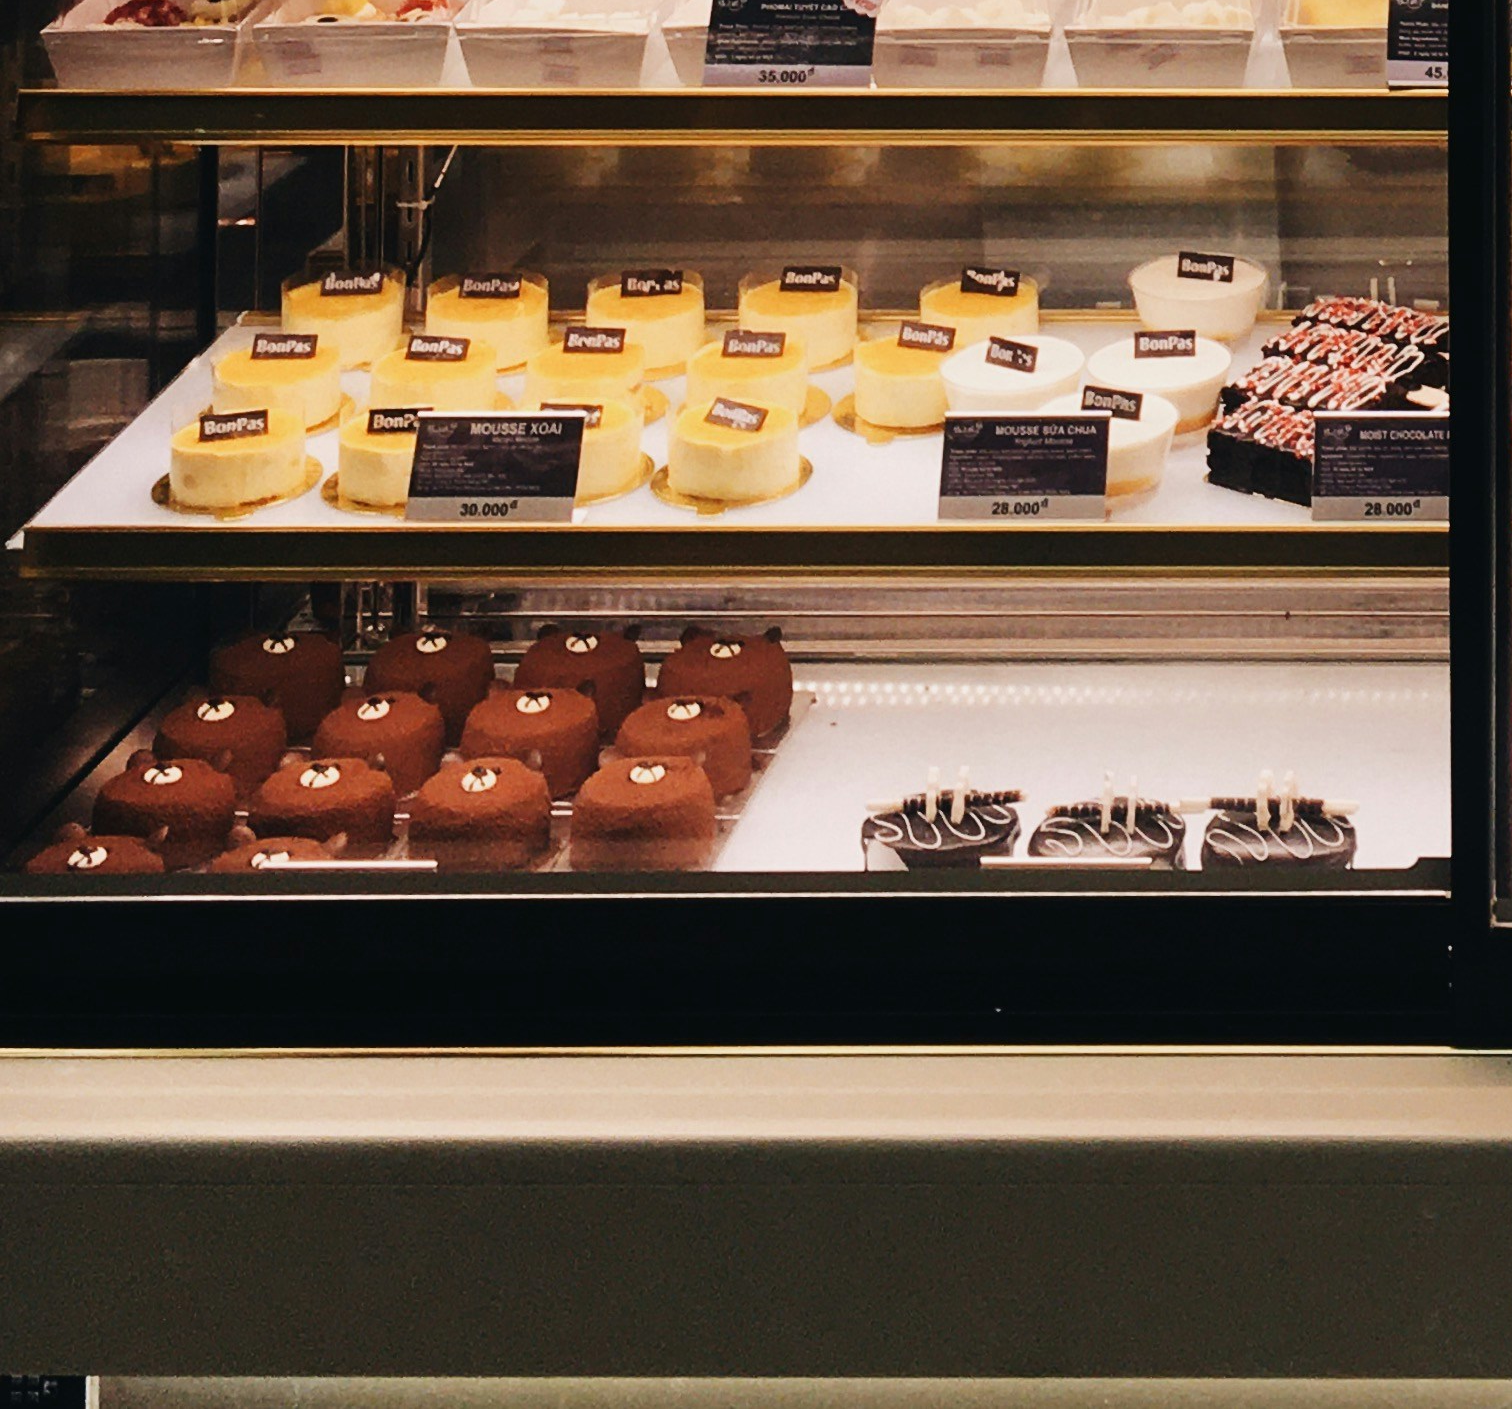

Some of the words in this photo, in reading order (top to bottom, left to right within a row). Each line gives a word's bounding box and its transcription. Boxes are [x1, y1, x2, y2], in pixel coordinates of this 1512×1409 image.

[785, 271, 835, 285] BonPas
[902, 326, 949, 347] BonPas
[256, 339, 311, 353] BonPas
[411, 338, 463, 355] BonPas
[728, 339, 781, 354] BonPas
[1139, 337, 1193, 352] BonPas
[204, 417, 265, 435] BonPas
[470, 423, 527, 435] MOUSSE
[995, 425, 1039, 436] MOUSSE
[1067, 425, 1097, 436] CHUA
[1360, 430, 1387, 440] MOIST
[1389, 430, 1444, 440] CHOCOLATE
